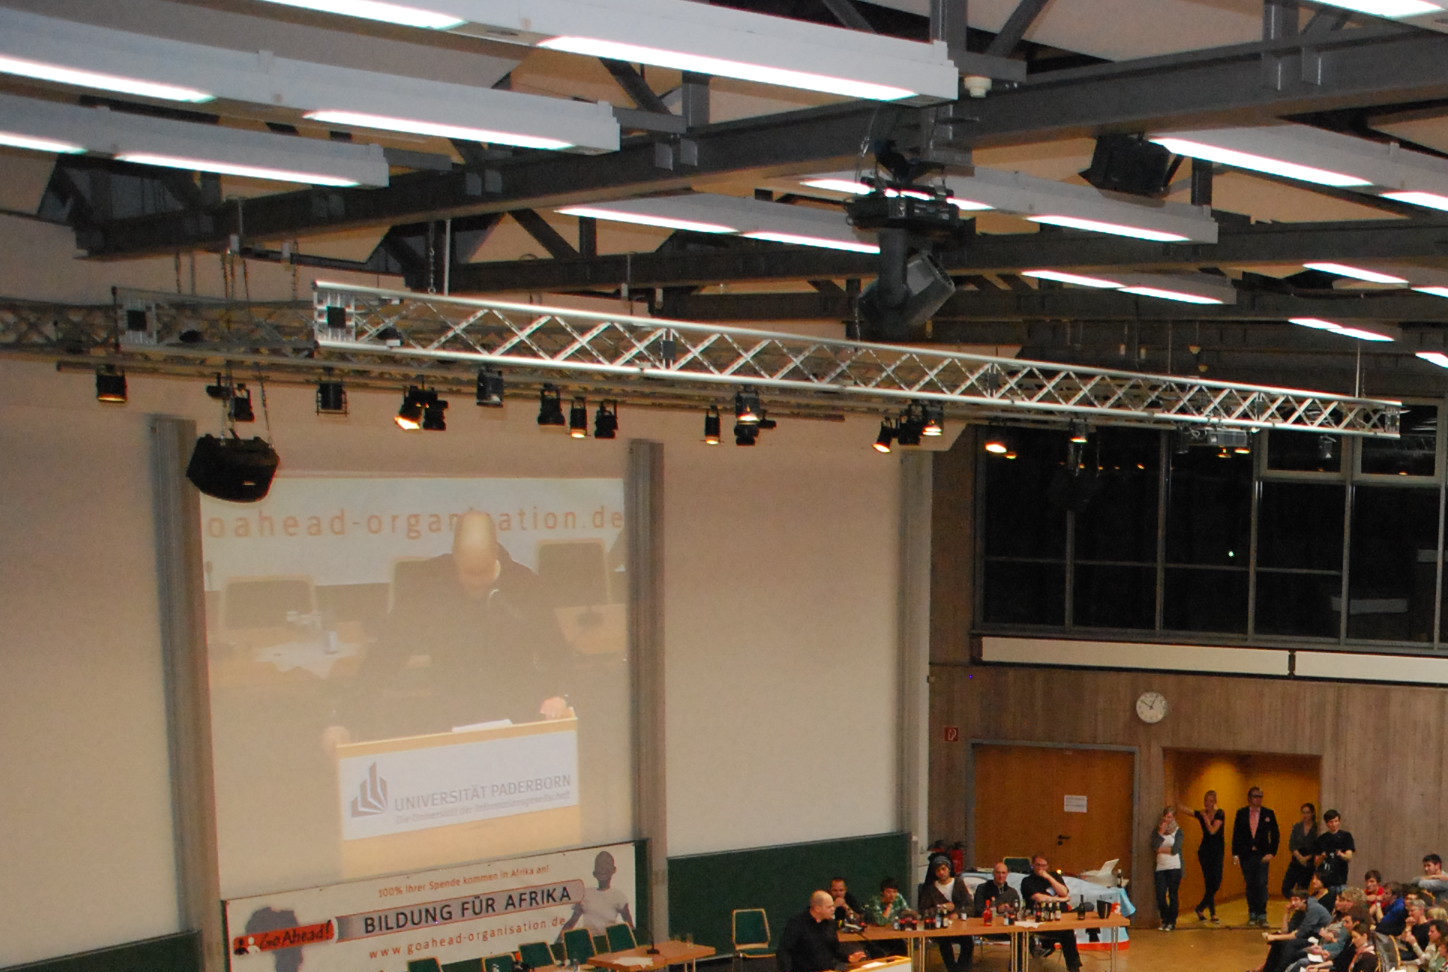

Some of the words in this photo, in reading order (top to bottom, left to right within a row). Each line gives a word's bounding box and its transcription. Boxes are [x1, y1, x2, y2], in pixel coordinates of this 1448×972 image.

[207, 505, 624, 541] oahead-organation.de
[394, 783, 488, 812] UNIVERSITÄT
[491, 774, 571, 798] PADERBORN
[379, 885, 403, 898] 100%
[405, 883, 426, 894] Ihrer
[429, 878, 461, 891] Spende
[463, 873, 498, 884] kommen
[512, 866, 534, 878] Afrika
[364, 904, 453, 934] BILDUNG
[461, 895, 496, 918] FÜR
[504, 886, 572, 910] AFRIKA
